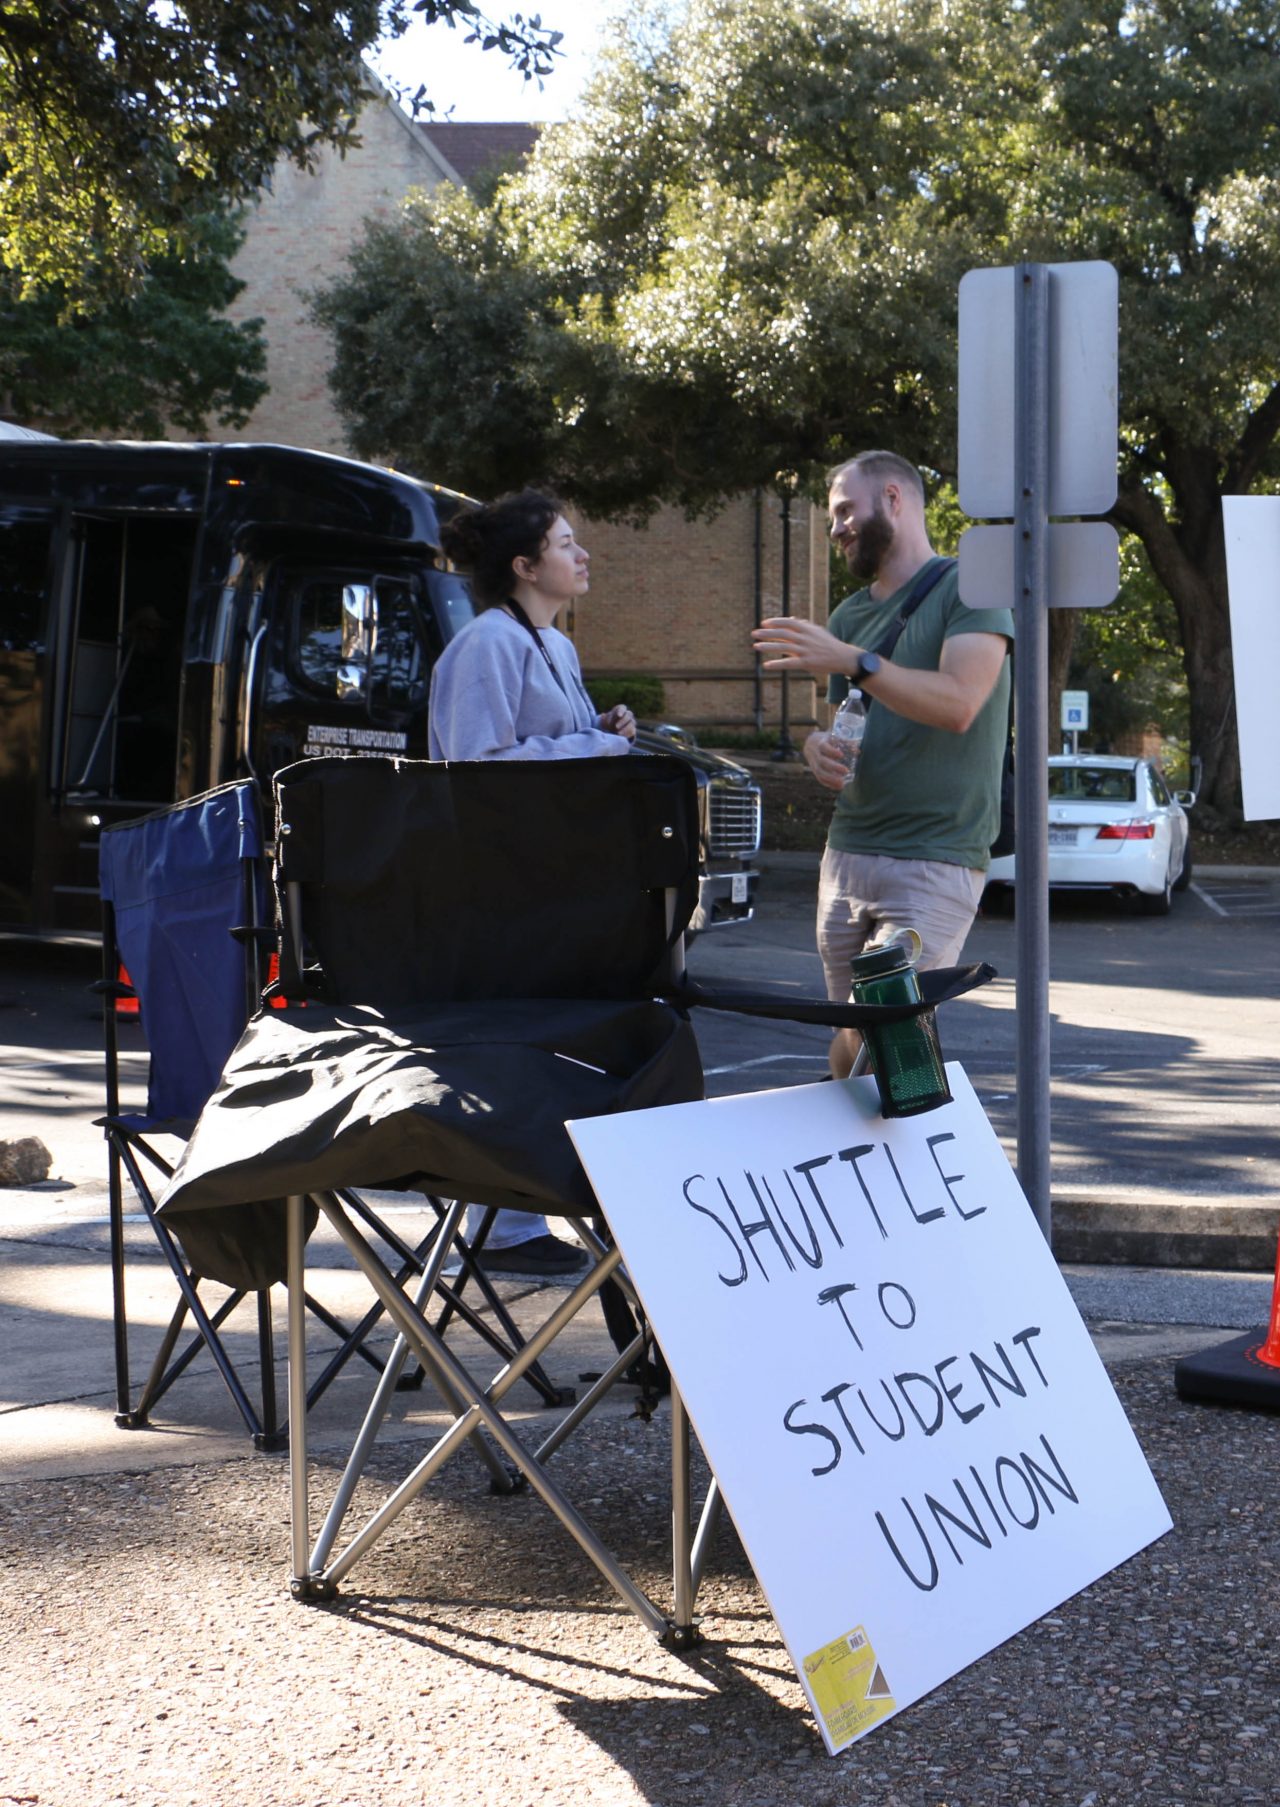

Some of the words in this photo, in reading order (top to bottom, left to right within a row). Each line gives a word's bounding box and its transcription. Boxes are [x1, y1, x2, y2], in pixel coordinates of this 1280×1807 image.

[303, 744, 320, 756] US
[323, 746, 351, 757] DOT
[307, 725, 347, 745] ENTERPRISE
[348, 728, 407, 750] TRANSPORTATION
[683, 1133, 988, 1287] SHUTTLE
[817, 1282, 917, 1351] TO
[784, 1326, 1048, 1476] STUDENT
[875, 1434, 1080, 1592] UNION
